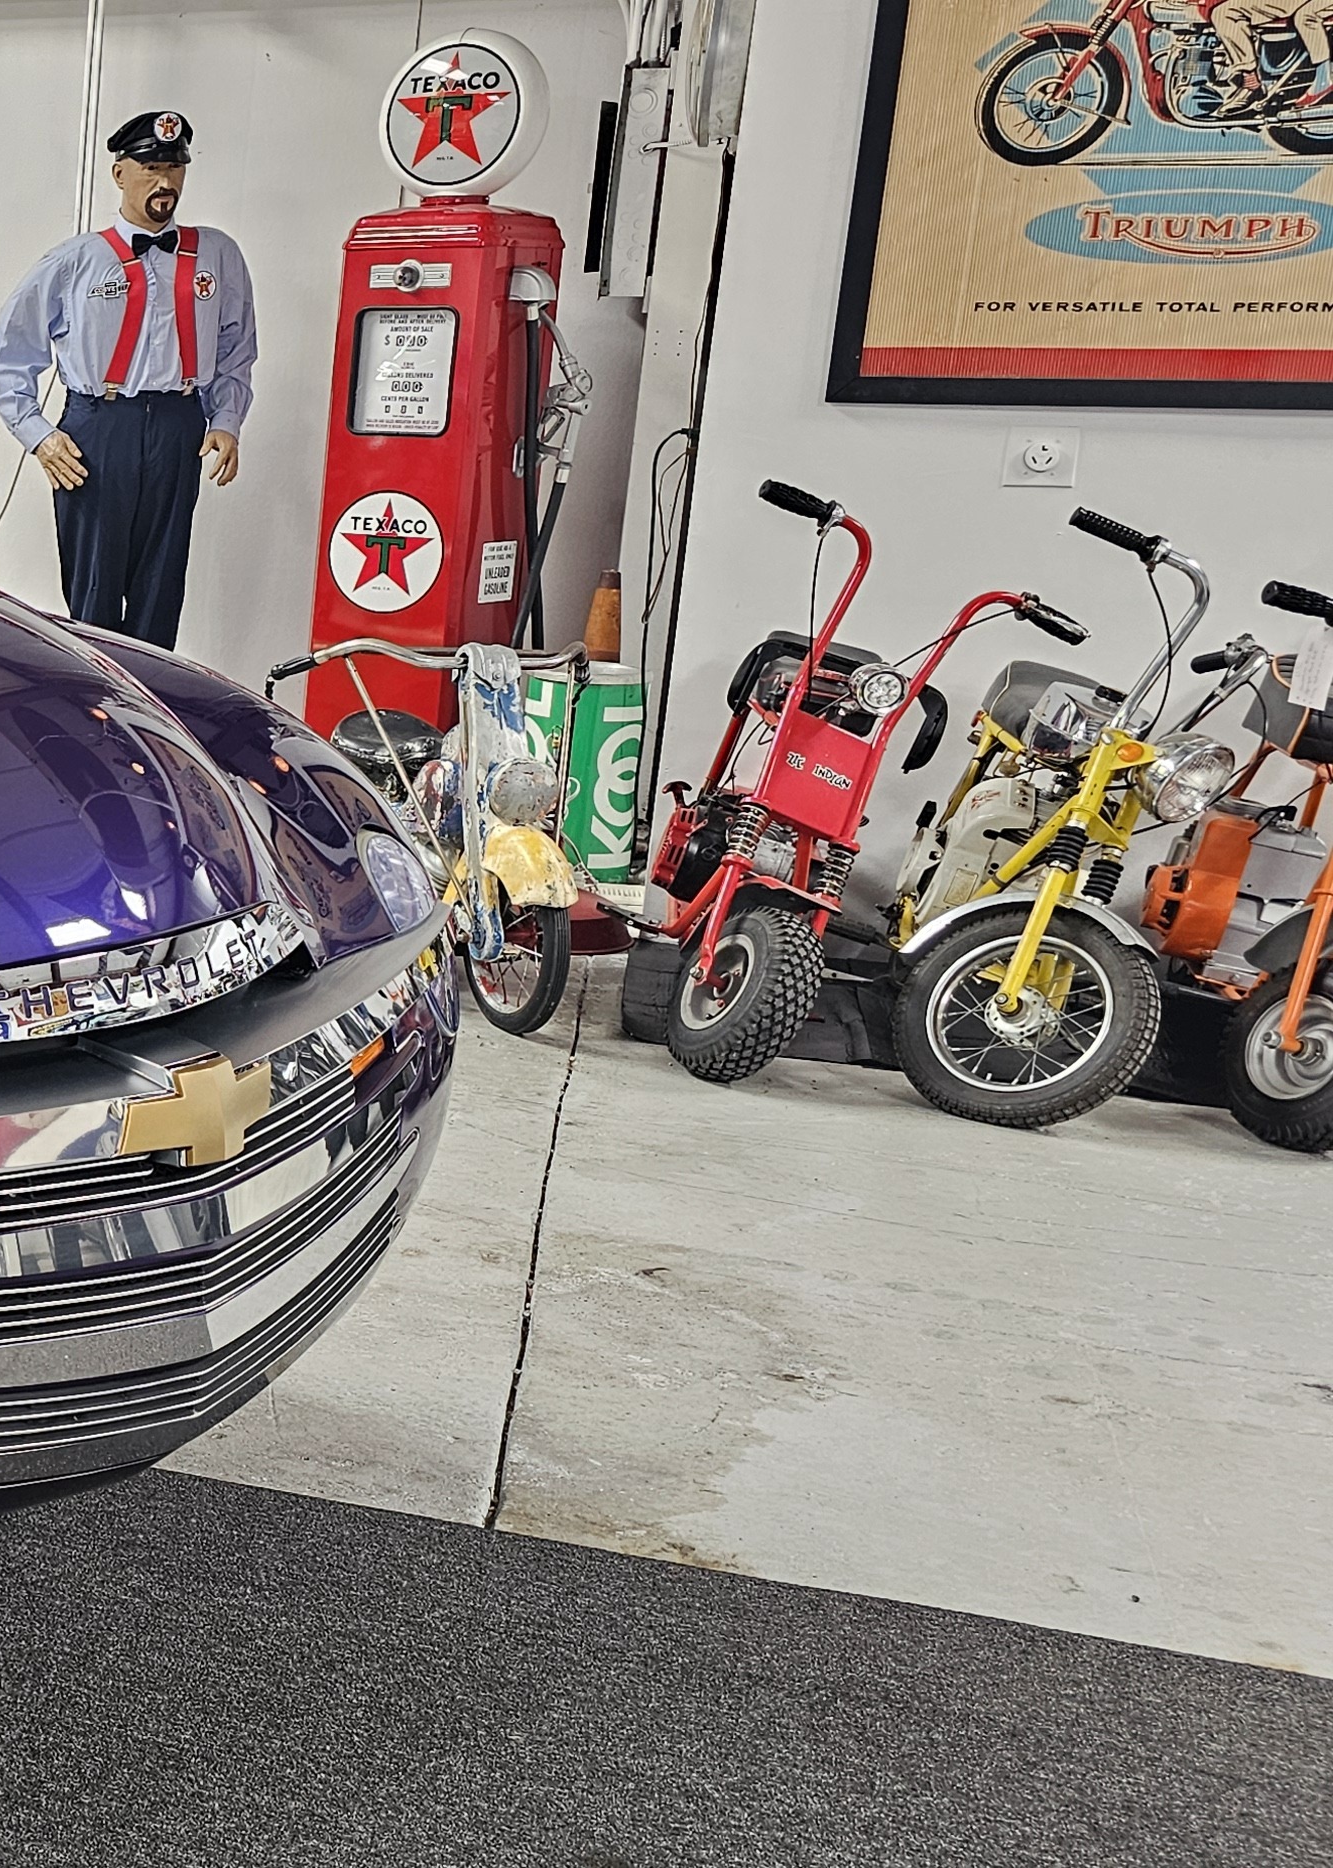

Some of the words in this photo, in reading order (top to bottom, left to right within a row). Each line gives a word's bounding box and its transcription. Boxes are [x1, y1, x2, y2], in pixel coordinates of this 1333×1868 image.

[411, 72, 500, 94] TEXACO
[1082, 206, 1317, 250] TRIUMPH
[974, 301, 1016, 312] FOR
[1028, 301, 1144, 313] VERSATILE
[1156, 302, 1221, 313] TOTAL
[1233, 302, 1333, 313] PERFORM
[384, 334, 390, 346] $
[351, 516, 427, 534] TEXACO
[485, 566, 510, 579] UNLEADED
[484, 581, 508, 595] GASOLINE
[813, 765, 851, 788] INDIAN
[587, 706, 644, 869] KOOL
